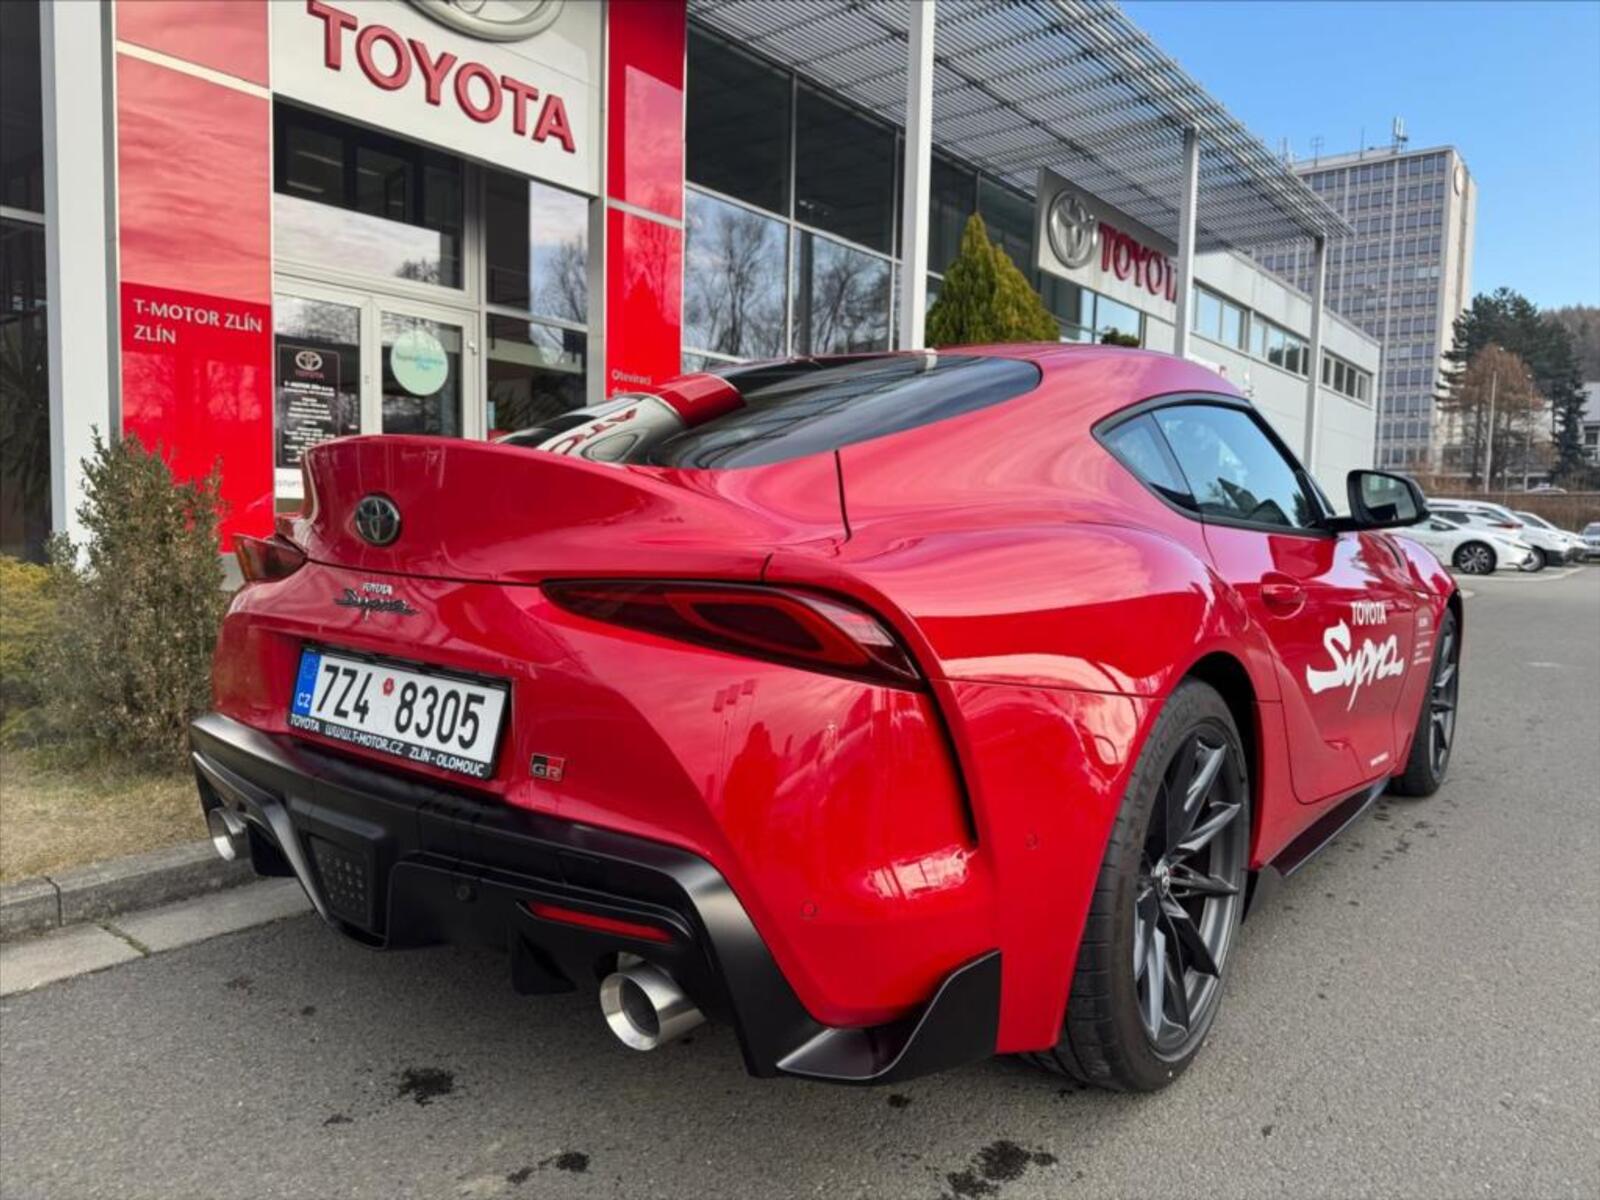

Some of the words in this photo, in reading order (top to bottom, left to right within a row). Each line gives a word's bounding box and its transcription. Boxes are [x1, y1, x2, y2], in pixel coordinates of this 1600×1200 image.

[307, 0, 576, 154] TOYOTA
[1098, 221, 1178, 304] TOYOT
[133, 298, 220, 327] T-MOTOR
[224, 313, 262, 333] ZLÍN
[133, 324, 176, 344] ZLÍN
[1350, 600, 1387, 626] TOYOTA
[1306, 617, 1404, 712] Supra
[296, 692, 312, 709] CZ
[316, 663, 373, 725] 7Z4
[394, 680, 486, 750] 8305
[290, 713, 321, 733] TOYOTA
[324, 723, 405, 755] WWW.T-MOTOR.CZ
[435, 754, 485, 778] OLOMOUC
[531, 763, 561, 780] GR
